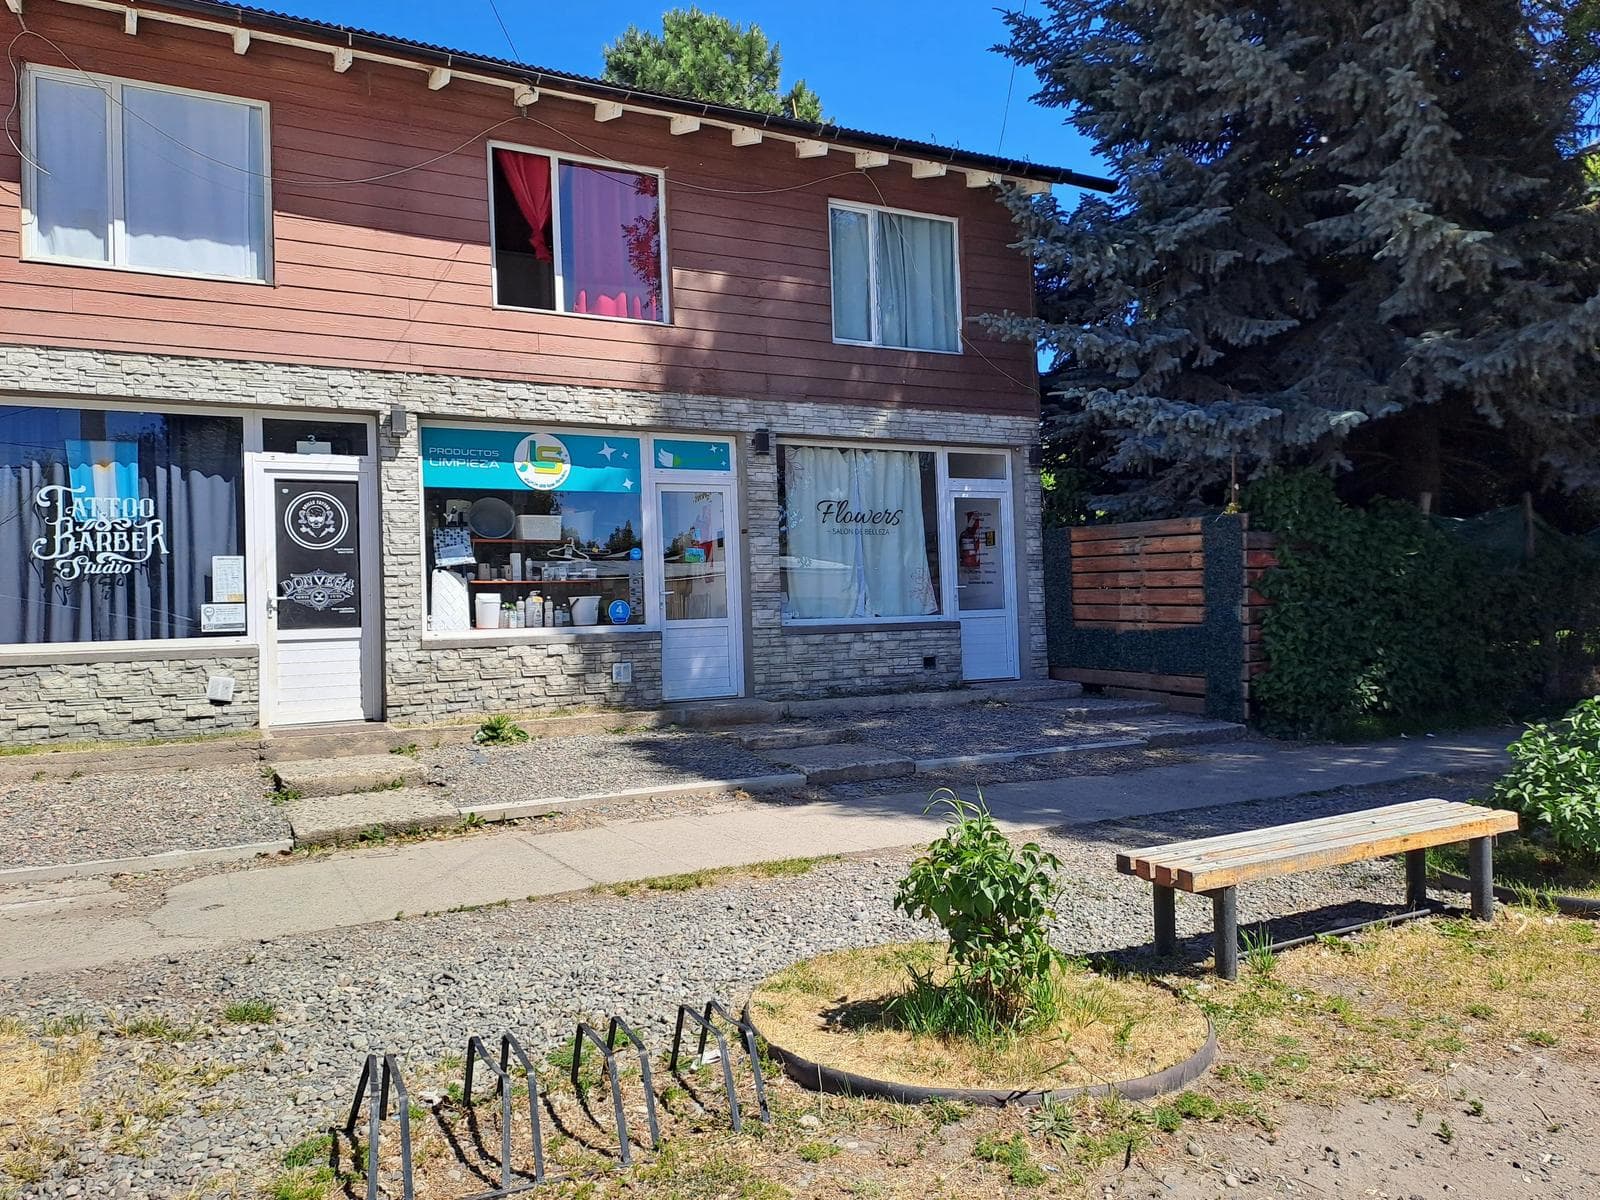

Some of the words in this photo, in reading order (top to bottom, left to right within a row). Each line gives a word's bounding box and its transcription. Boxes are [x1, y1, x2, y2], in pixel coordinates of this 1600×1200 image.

[307, 434, 316, 446] 3
[428, 447, 500, 457] PRODUCTOS
[429, 458, 500, 469] LIMPIEZA
[36, 485, 155, 518] TATTOO
[816, 499, 904, 526] Flowers
[32, 517, 170, 563] BARBER
[832, 528, 854, 536] SALON
[855, 528, 863, 536] DE
[864, 528, 890, 536] BELLEZA
[55, 555, 132, 580] Studio
